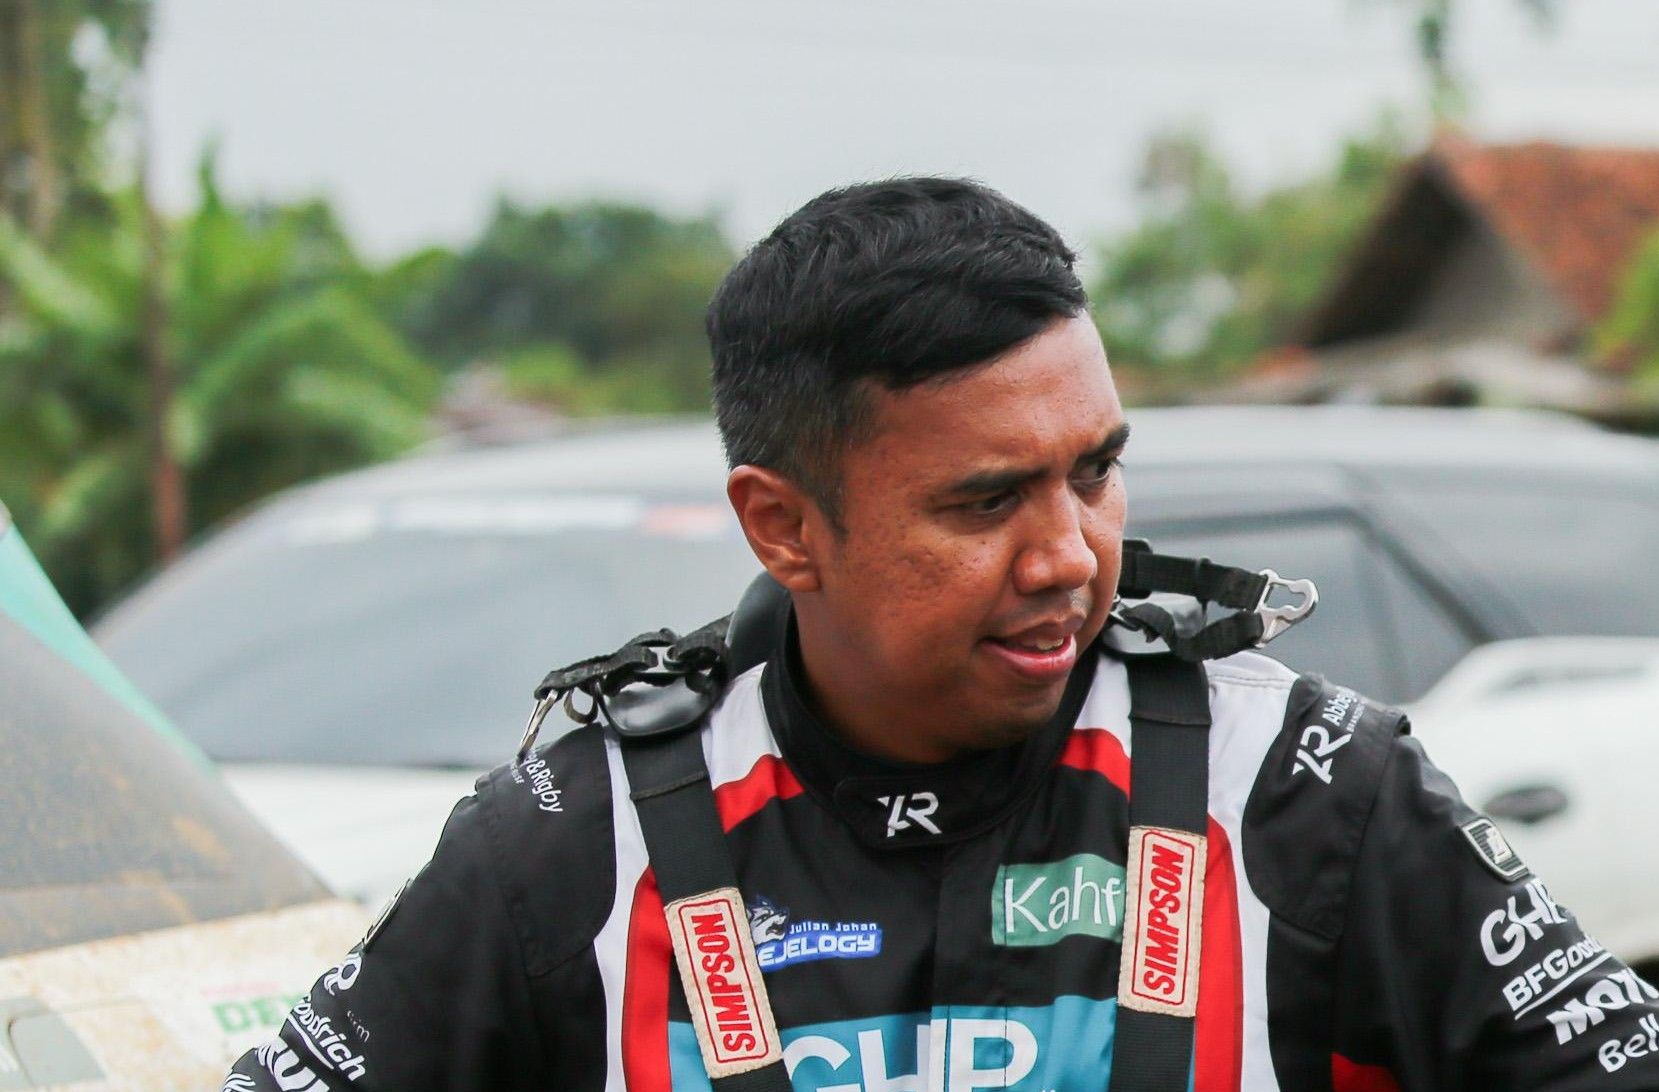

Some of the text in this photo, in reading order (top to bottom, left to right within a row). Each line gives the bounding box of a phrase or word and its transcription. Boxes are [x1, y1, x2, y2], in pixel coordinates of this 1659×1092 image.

[790, 922, 878, 935] Julian Johan
[1004, 866, 1122, 934] Kahf
[1142, 843, 1185, 996] SIMPSON
[691, 912, 756, 1053] SIMPSON
